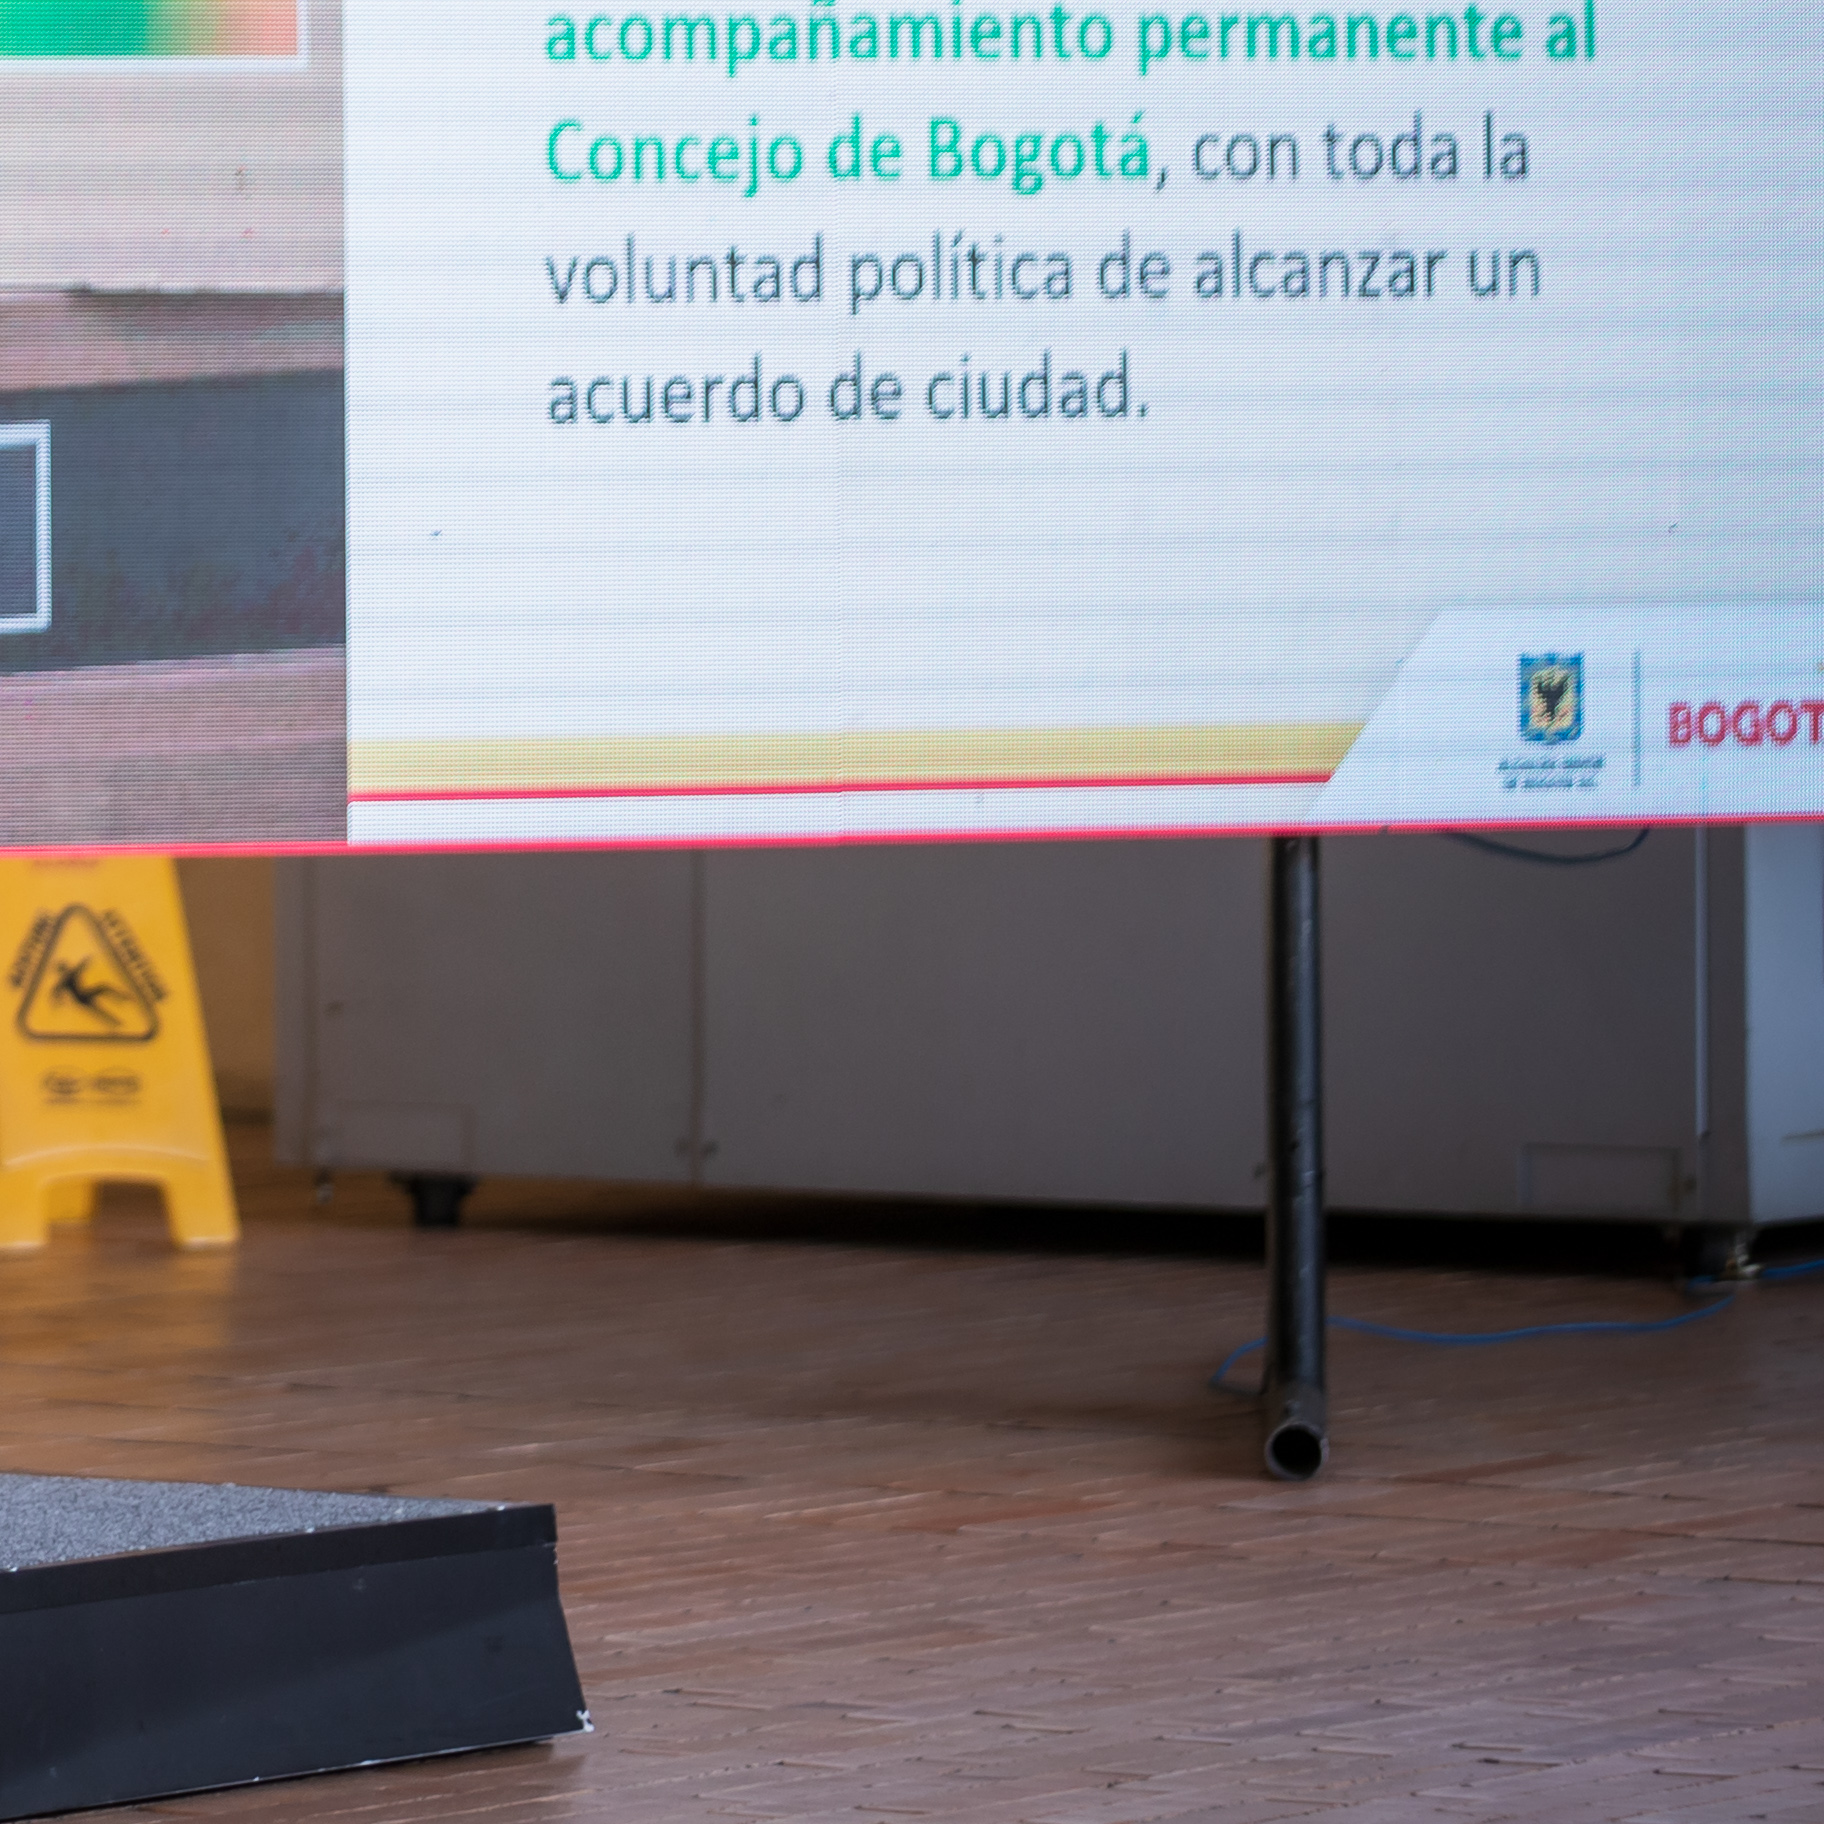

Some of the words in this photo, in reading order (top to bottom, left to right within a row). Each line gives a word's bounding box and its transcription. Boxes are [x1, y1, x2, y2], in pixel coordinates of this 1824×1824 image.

[1136, 2, 1526, 78] permanente
[544, 113, 806, 200] Concejo
[824, 112, 904, 183] de
[927, 110, 1169, 198] Bogotá,
[1192, 134, 1300, 182] con
[1322, 112, 1460, 182] toda
[1483, 111, 1530, 181] la
[544, 234, 824, 306] voluntad
[849, 232, 1073, 317] política
[1097, 233, 1172, 301] de
[1194, 231, 1448, 300] alcanzar
[1467, 249, 1541, 298] un
[547, 354, 807, 427] acuerdo
[826, 352, 904, 423] de
[925, 350, 1148, 422] ciudad.
